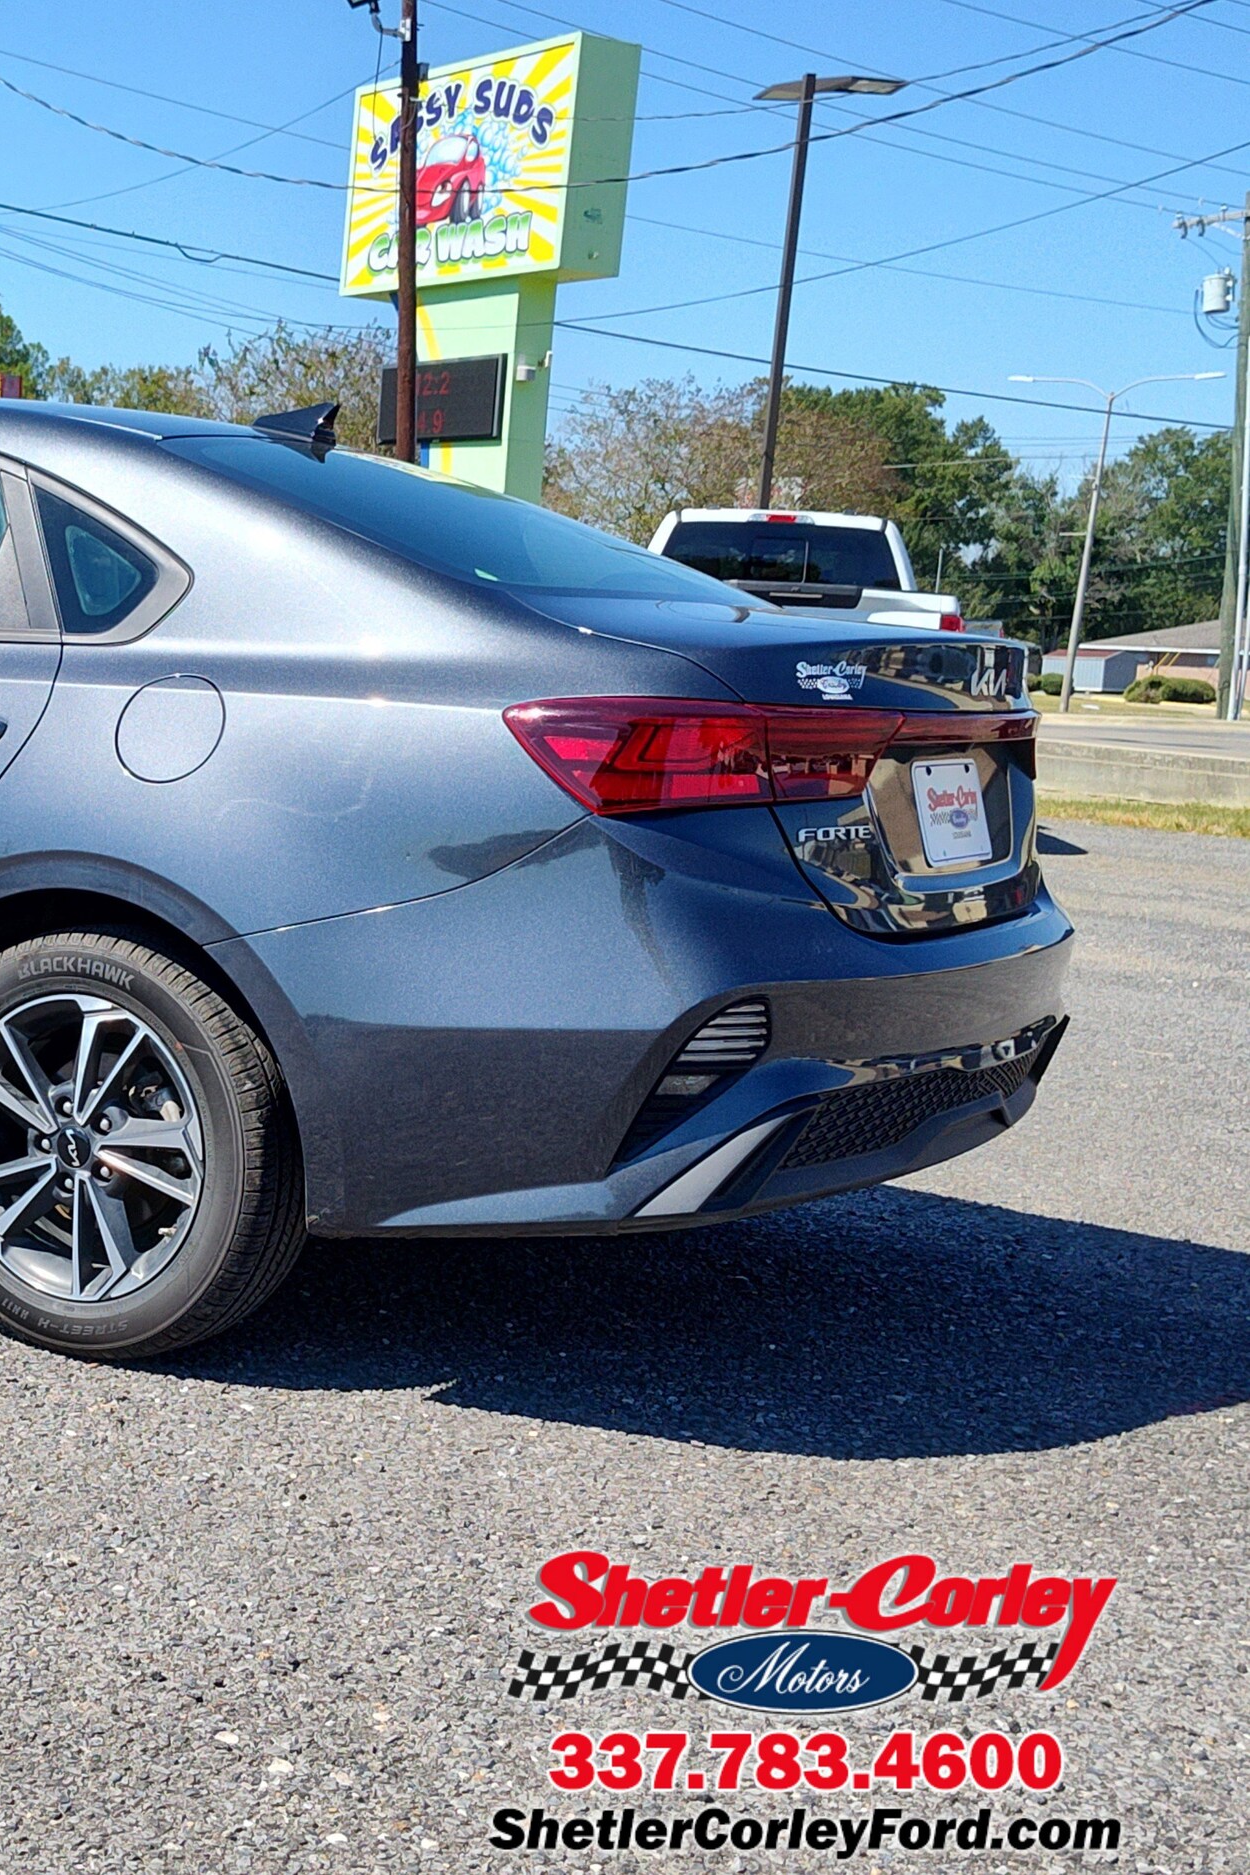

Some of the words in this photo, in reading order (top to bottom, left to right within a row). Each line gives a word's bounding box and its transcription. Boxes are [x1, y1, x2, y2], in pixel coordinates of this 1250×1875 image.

[474, 79, 554, 145] SUDS
[436, 211, 533, 263] WASH
[797, 825, 872, 843] FORTE
[18, 956, 136, 991] BLACKHAWK
